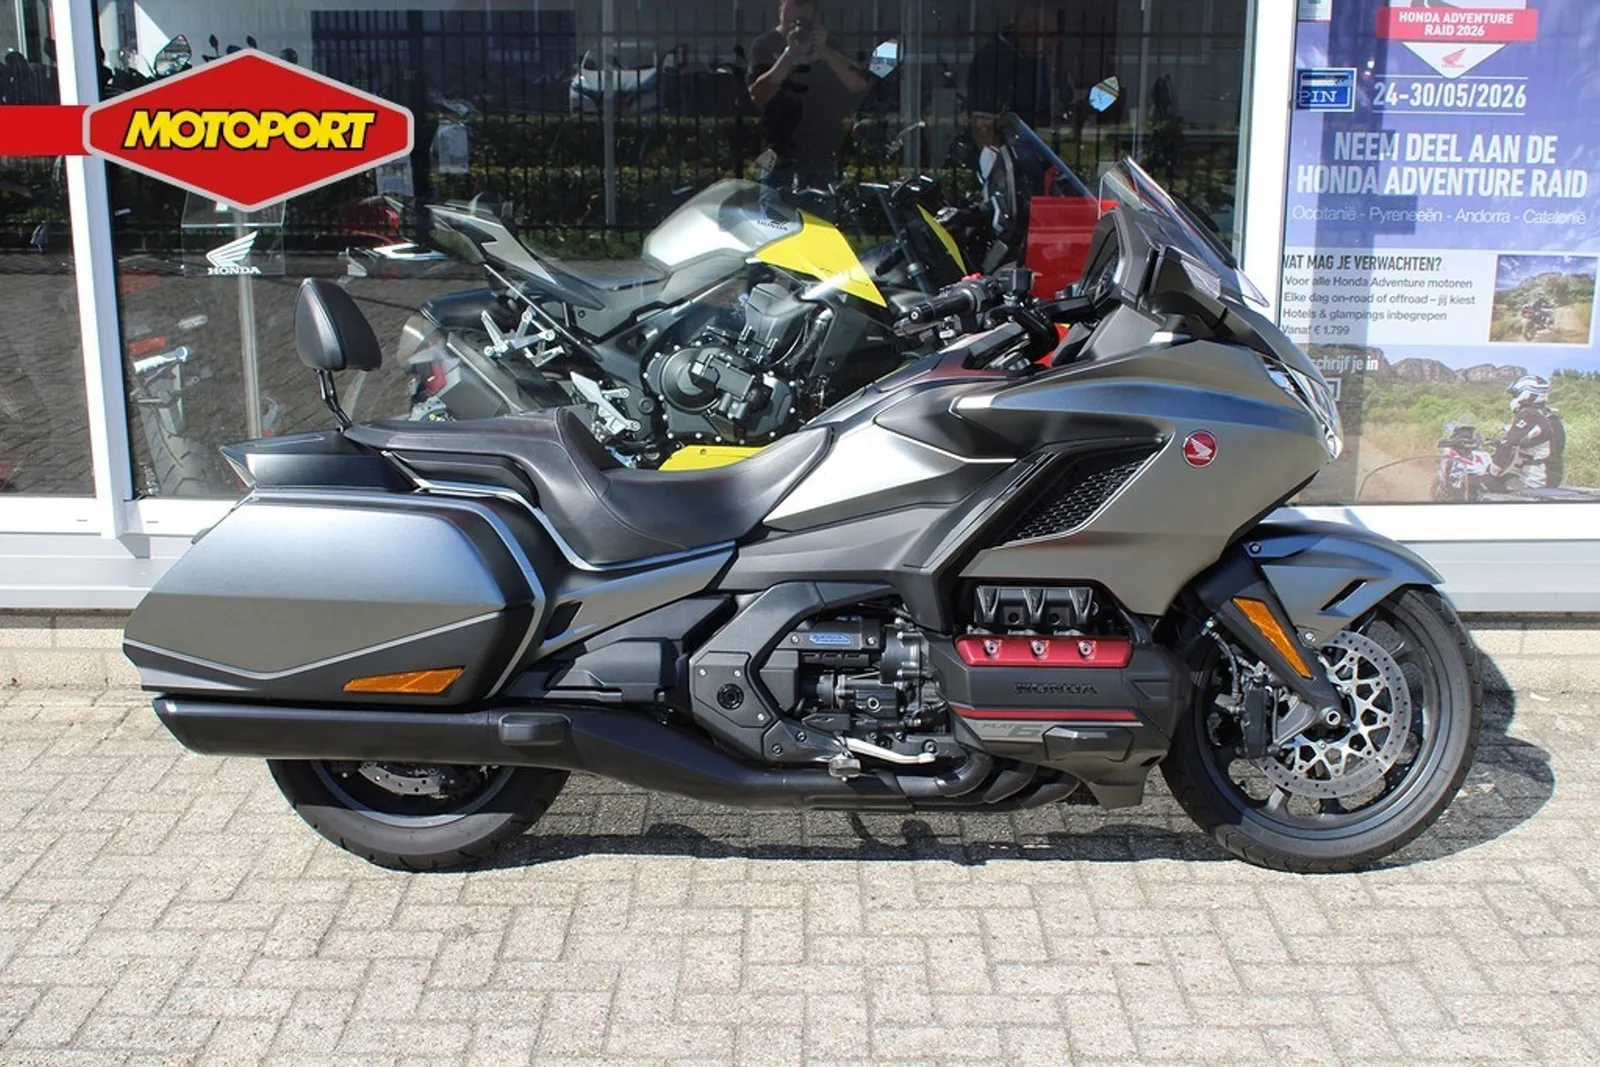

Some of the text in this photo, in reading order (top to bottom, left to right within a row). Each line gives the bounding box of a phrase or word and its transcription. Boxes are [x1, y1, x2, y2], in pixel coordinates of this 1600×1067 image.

[1399, 12, 1514, 24] HONDA ADVENTURE
[1424, 24, 1485, 36] RAID 2026
[1297, 90, 1337, 103] PIN
[1373, 82, 1527, 108] 24-30/05/2026
[1333, 131, 1558, 165] NEEM DEEL AAN DE
[1296, 164, 1588, 198] HONDA ADVENTURE RAID
[1292, 205, 1357, 221] Occitanië
[1369, 206, 1442, 225] Pyreneeën
[1455, 207, 1510, 224] Andorra
[1307, 254, 1335, 270] MAG
[1336, 254, 1352, 270] JE
[1354, 255, 1443, 271] VERWACHTEN?
[207, 266, 261, 275] HONDA
[1284, 276, 1473, 289] Voor alle Honda Adventure motoren
[1284, 292, 1306, 302] Elke
[1308, 293, 1329, 304] dag
[1331, 294, 1374, 304] on-road
[1376, 294, 1388, 304] of
[1389, 294, 1429, 305] offroad
[1449, 294, 1476, 305] kiest
[1283, 309, 1447, 322] Hotels & glampings inbegrepen
[1314, 325, 1321, 335] €
[1350, 355, 1364, 375] je
[1366, 355, 1379, 371] in
[1015, 682, 1098, 694] HONDA
